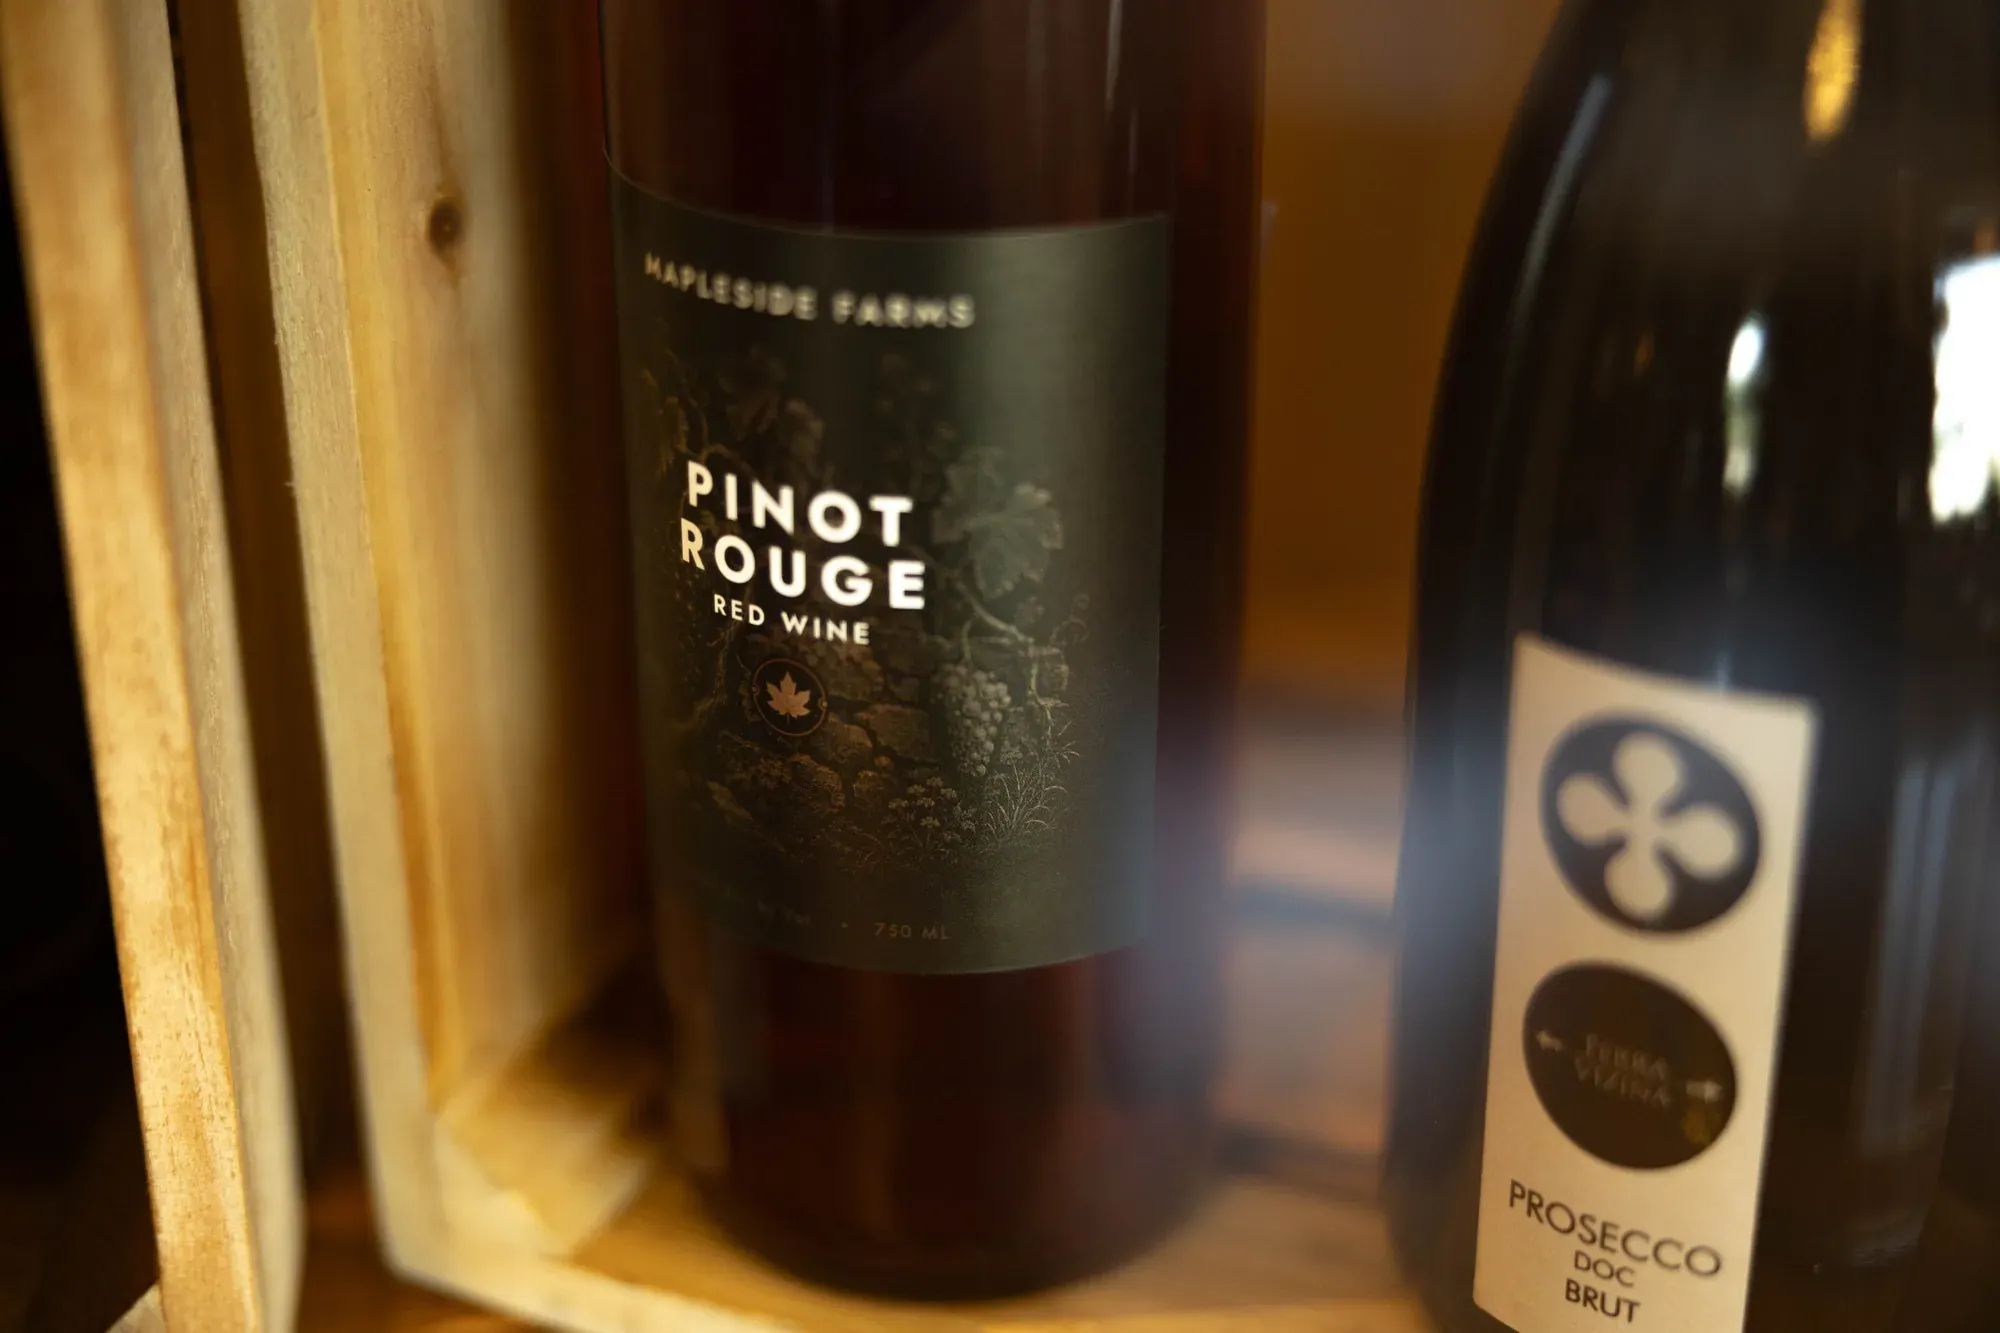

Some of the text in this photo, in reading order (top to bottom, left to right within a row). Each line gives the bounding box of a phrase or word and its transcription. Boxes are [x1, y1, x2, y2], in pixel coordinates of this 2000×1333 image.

[645, 251, 976, 329] MAPLESIDE FARMS
[687, 460, 914, 547] PINOT
[680, 517, 926, 610] ROUGE
[714, 593, 870, 645] RED WINE
[873, 922, 952, 939] 750 ML
[1509, 1178, 1722, 1278] PROSECCO
[1564, 1278, 1641, 1324] BRUT
[1573, 1250, 1636, 1288] DOC
